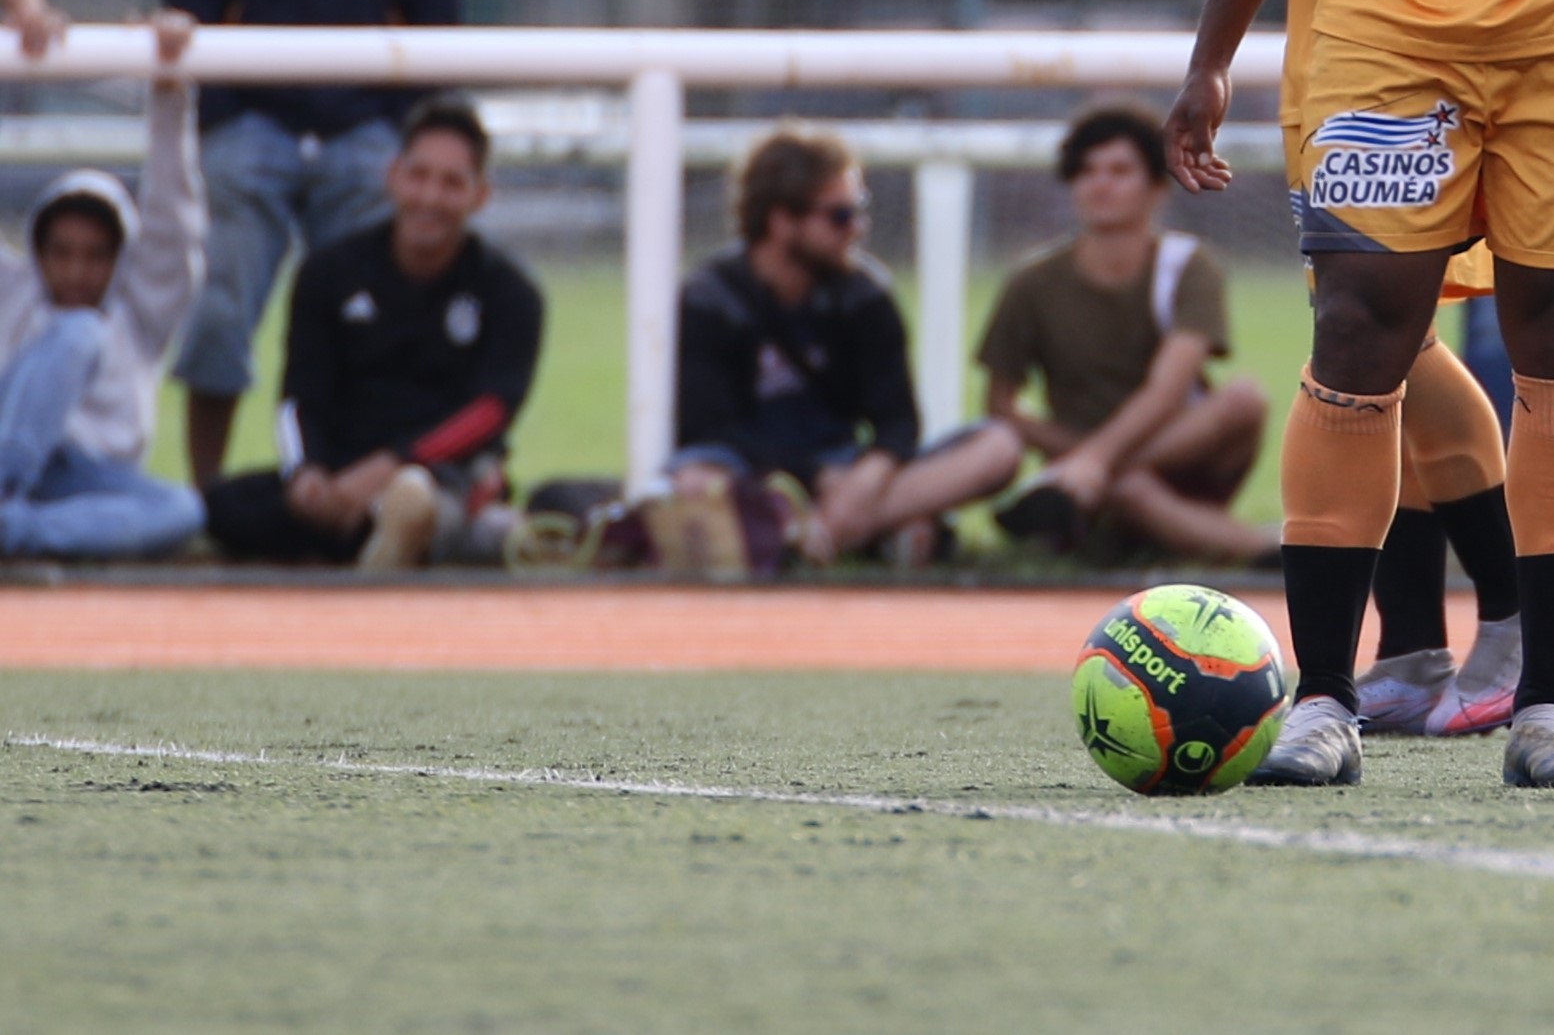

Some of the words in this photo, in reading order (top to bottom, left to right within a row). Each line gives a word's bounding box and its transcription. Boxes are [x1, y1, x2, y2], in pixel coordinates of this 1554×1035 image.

[1325, 152, 1451, 176] CASINOS
[1312, 175, 1437, 204] NOUMÉA
[1103, 617, 1187, 695] uhlsport
